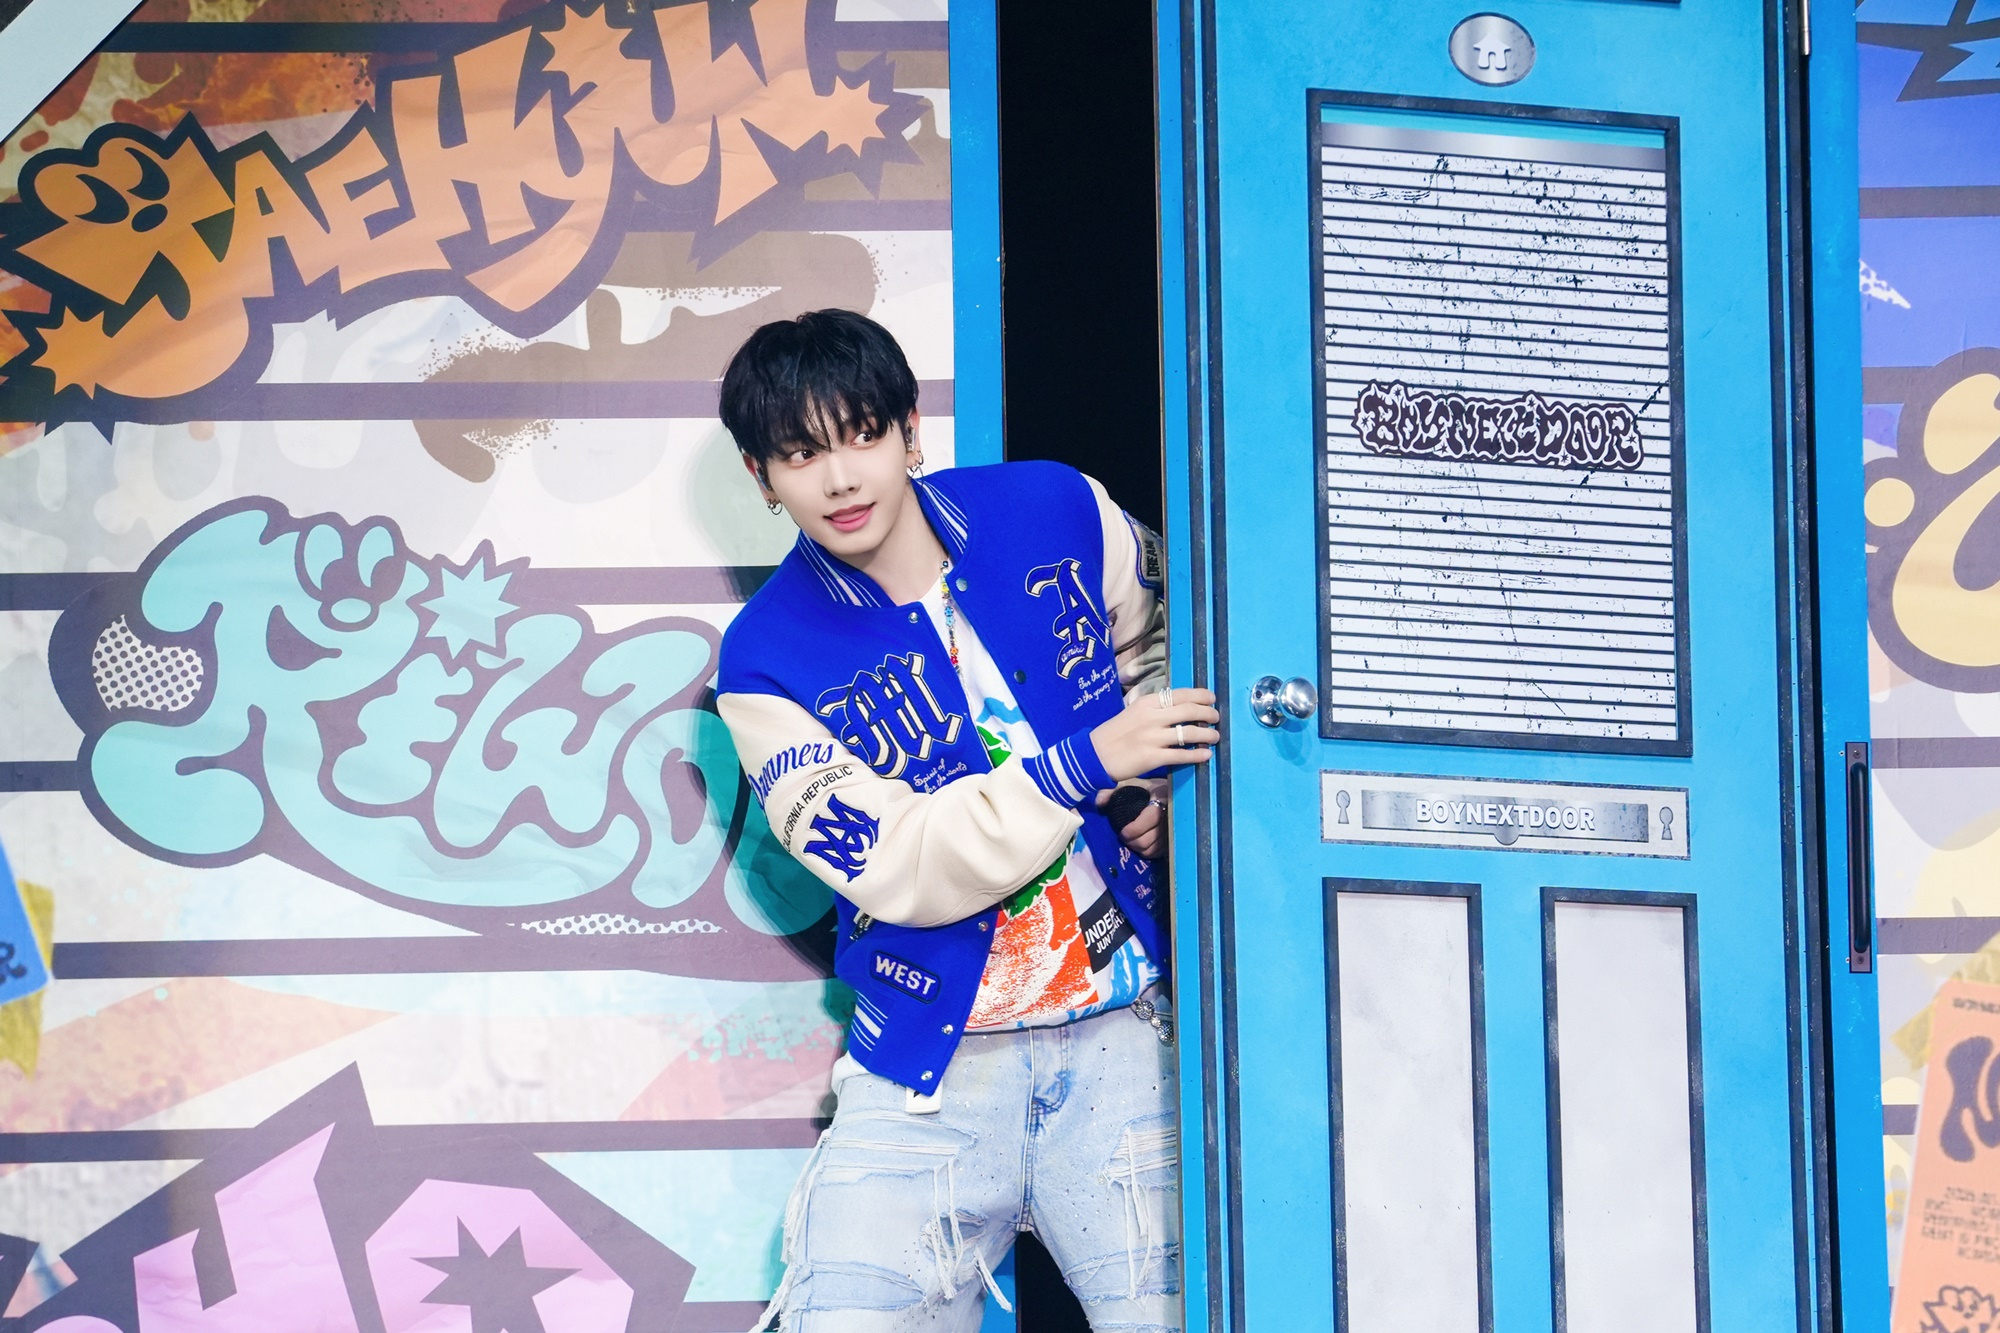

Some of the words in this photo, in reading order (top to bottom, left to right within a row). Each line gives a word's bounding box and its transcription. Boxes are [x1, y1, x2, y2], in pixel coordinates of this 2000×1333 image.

[1355, 384, 1642, 469] BOYNEXTDOOR
[938, 757, 946, 772] of
[802, 765, 853, 805] REPUBLIC
[1416, 799, 1596, 831] BOYNEXTDOOR
[876, 955, 936, 995] WEST
